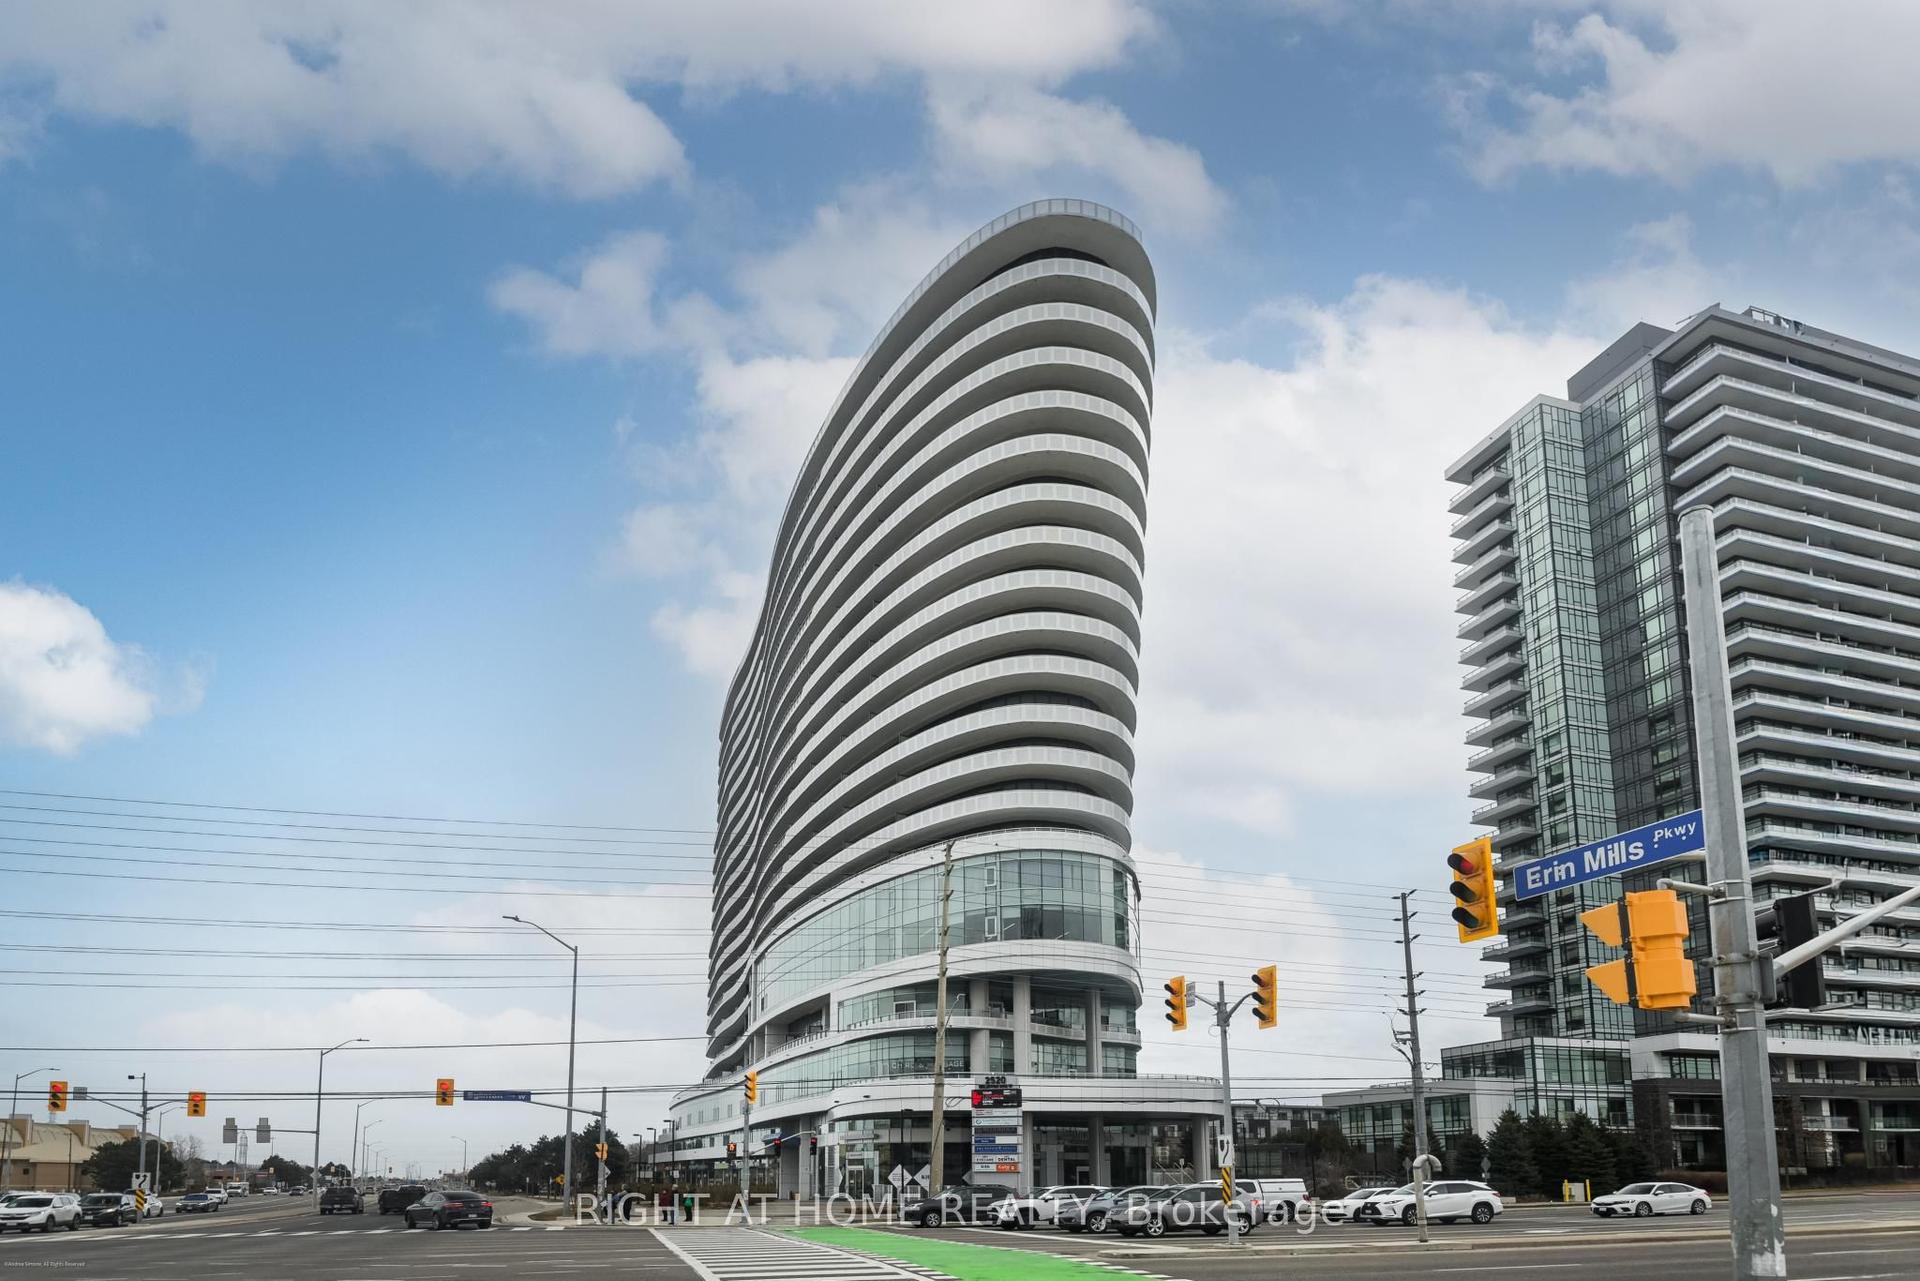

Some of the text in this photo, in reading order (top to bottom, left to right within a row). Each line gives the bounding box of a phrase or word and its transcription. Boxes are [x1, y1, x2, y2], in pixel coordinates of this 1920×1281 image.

[1526, 821, 1697, 890] Erin Mills Pkwy
[984, 1076, 1007, 1084] 2520
